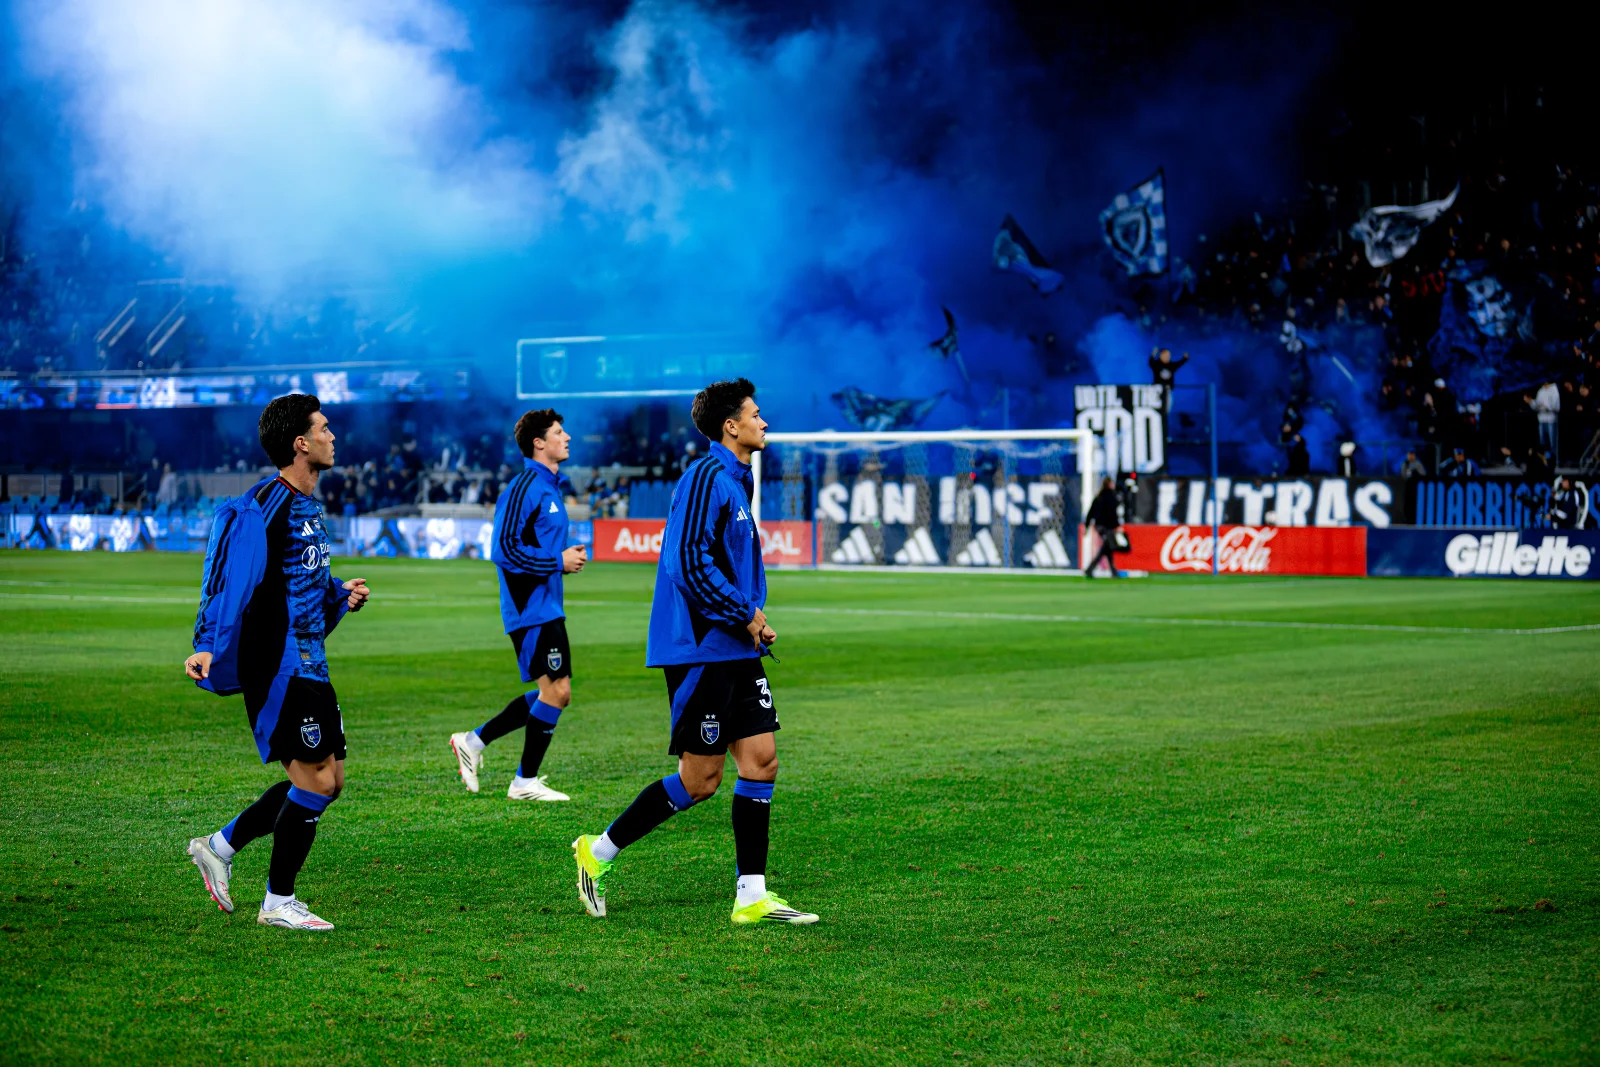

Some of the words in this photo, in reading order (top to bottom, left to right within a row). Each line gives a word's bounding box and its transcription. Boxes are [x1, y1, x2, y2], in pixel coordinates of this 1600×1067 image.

[816, 480, 916, 525] SAN
[1156, 477, 1393, 528] ULTRAS
[613, 527, 665, 553] Aud
[1160, 525, 1278, 572] CocaCola
[1445, 532, 1592, 577] Gillette
